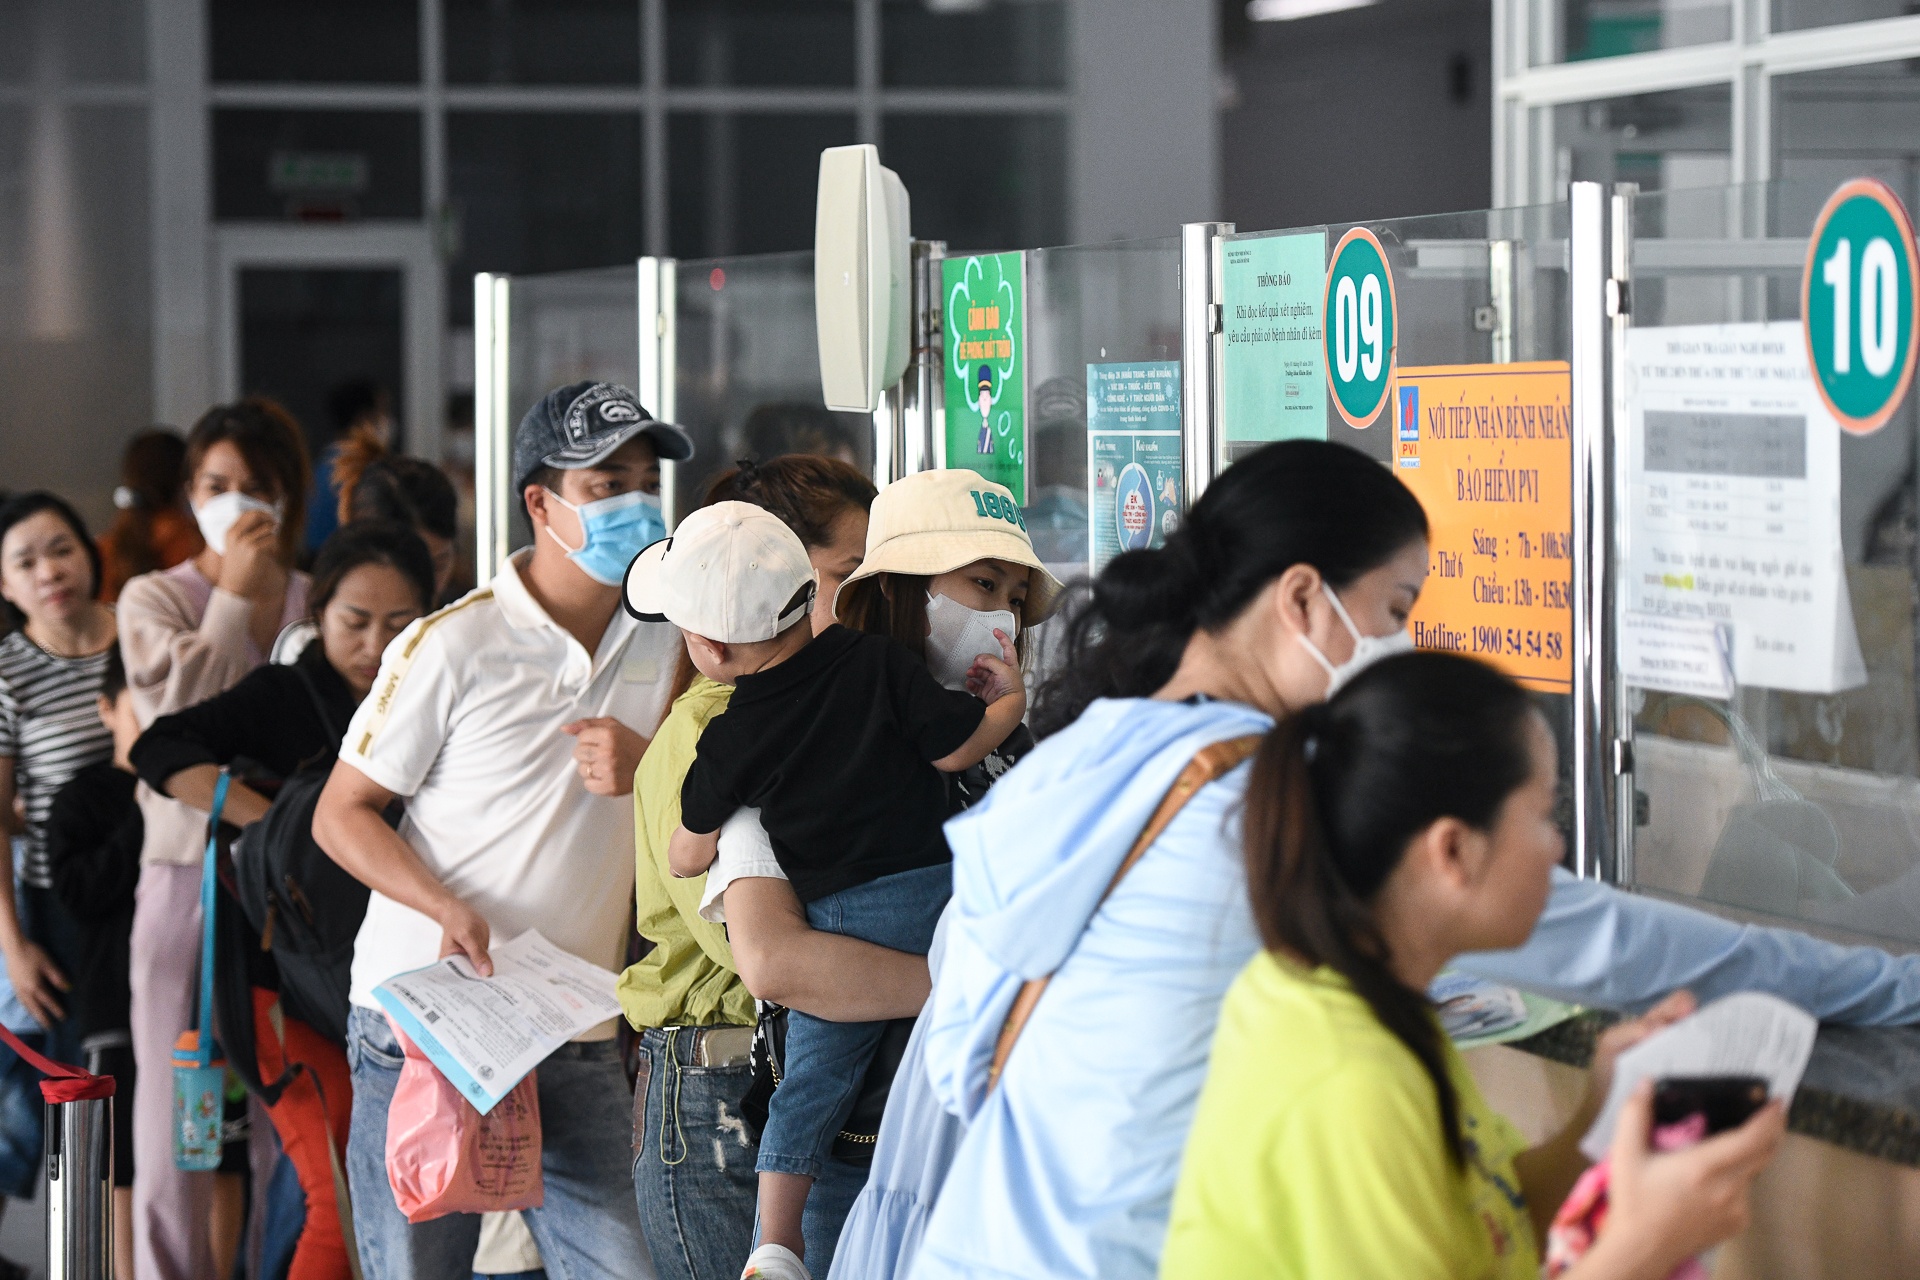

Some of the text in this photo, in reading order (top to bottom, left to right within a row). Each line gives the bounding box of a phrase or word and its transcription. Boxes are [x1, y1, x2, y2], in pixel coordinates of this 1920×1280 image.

[1257, 270, 1291, 287] THÔNG BÁO
[1236, 305, 1246, 318] Khi
[1248, 305, 1257, 320] đọc
[1259, 302, 1268, 318] kết
[1269, 302, 1279, 321] quả
[1280, 303, 1289, 316] xét
[1823, 237, 1899, 378] 10
[1228, 330, 1239, 346] yêu
[1252, 328, 1263, 346] phải
[1264, 328, 1270, 341] có
[1272, 327, 1285, 343] bệnh
[1287, 327, 1300, 340] nhân
[1301, 327, 1308, 340] đi
[1309, 326, 1321, 340] kèm
[1336, 273, 1383, 382] 09
[1428, 389, 1570, 446] NƠI TIẾP NHẬN BỆNH NHÂN
[1402, 443, 1417, 455] PVI
[1457, 449, 1539, 503] BẢO HIỂM PVI
[1473, 528, 1497, 563] Sáng
[1519, 532, 1530, 558] 7h
[1458, 553, 1464, 579] 6
[1473, 571, 1504, 605] Chiều
[1514, 579, 1533, 606] 13h
[1414, 621, 1562, 660] Hotline: 1900 54 54 58
